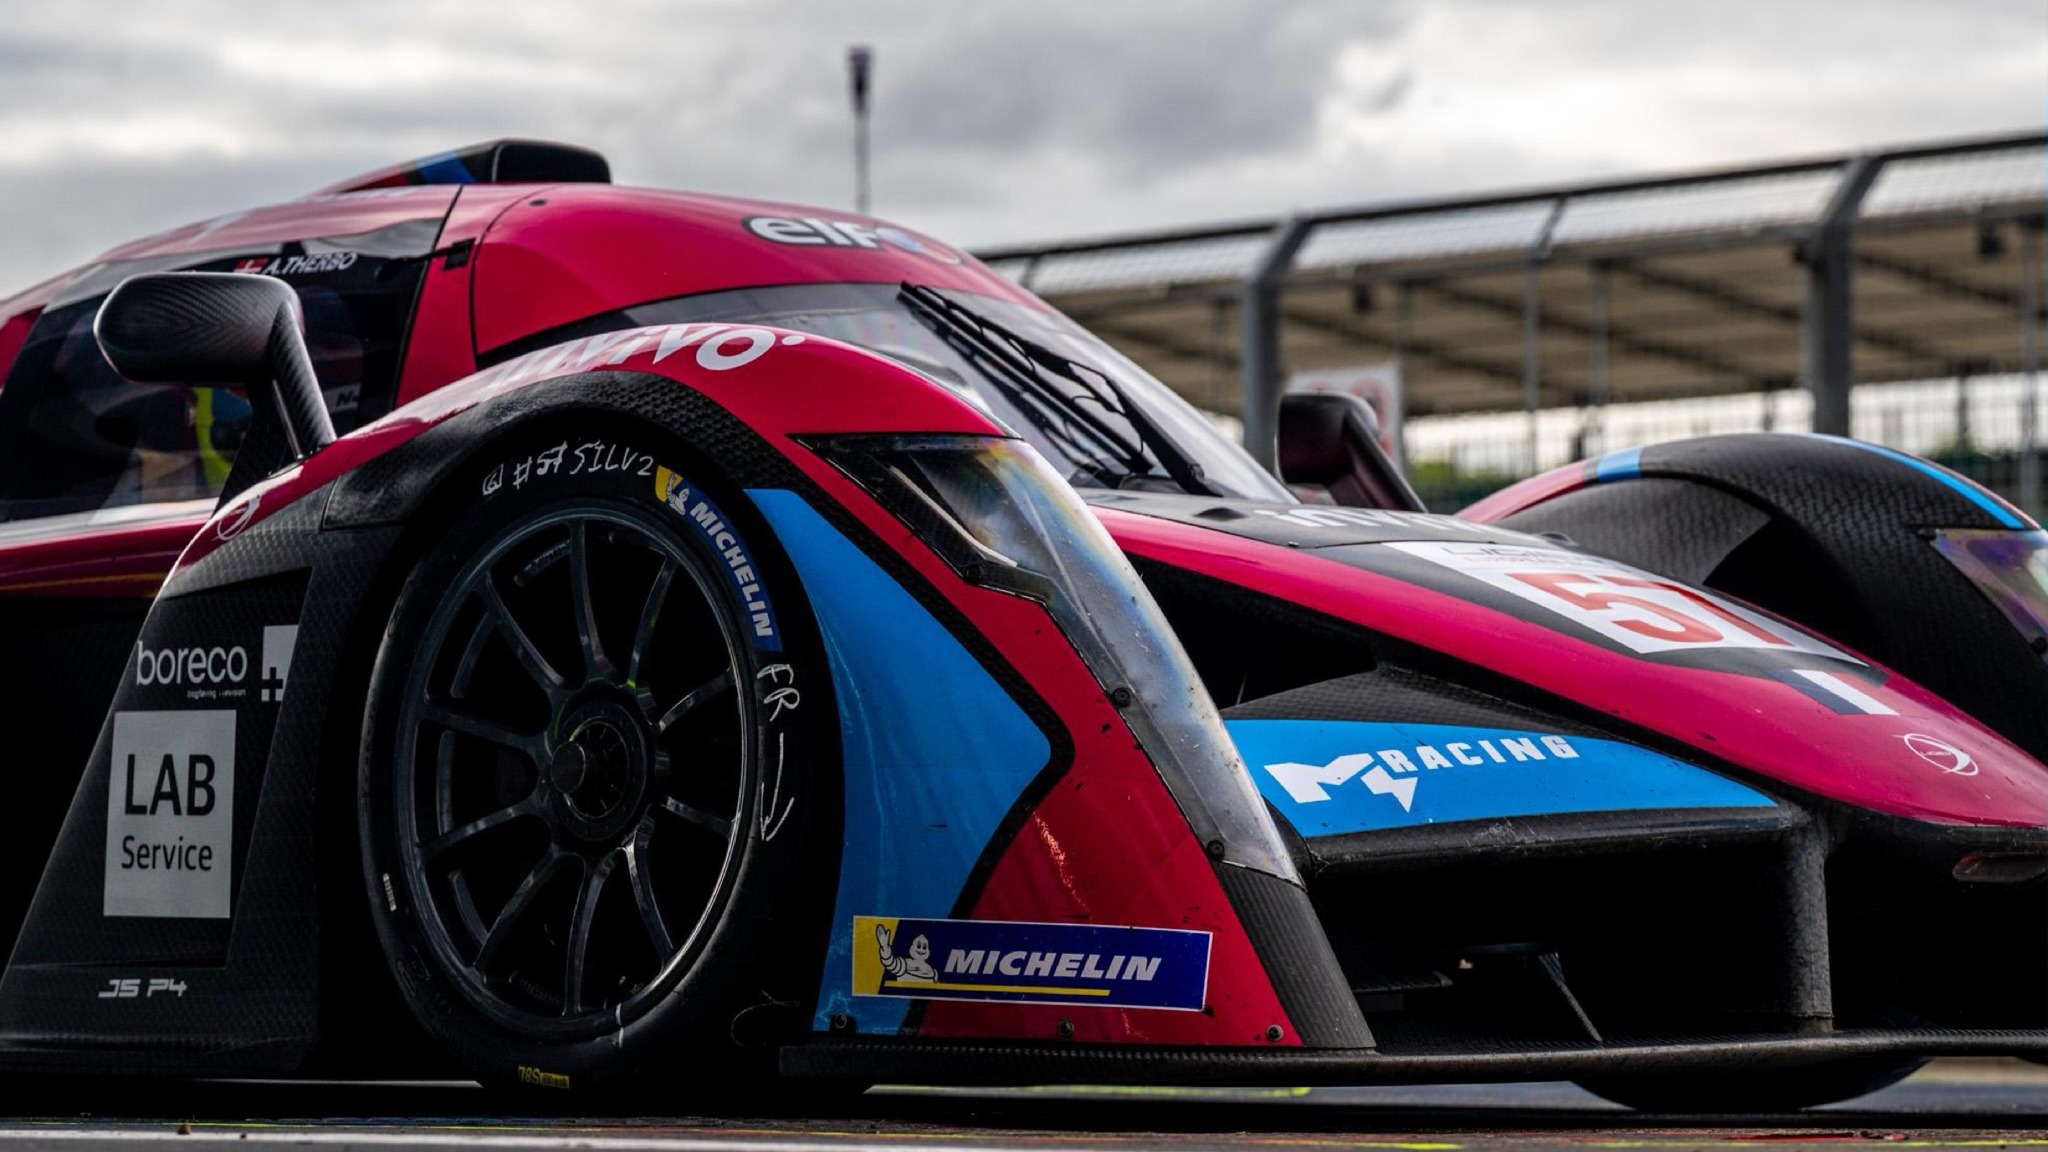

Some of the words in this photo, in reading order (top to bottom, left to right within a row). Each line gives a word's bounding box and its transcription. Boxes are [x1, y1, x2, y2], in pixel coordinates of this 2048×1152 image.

[748, 216, 880, 248] elf
[689, 501, 774, 637] MICHELIN
[1504, 573, 1797, 646] 57
[136, 640, 248, 685] boreco
[1376, 735, 1580, 773] RACING
[124, 753, 216, 817] LAB
[121, 834, 213, 872] Service
[943, 948, 1163, 982] MICHELIN
[98, 978, 141, 998] JS
[146, 978, 188, 998] P4
